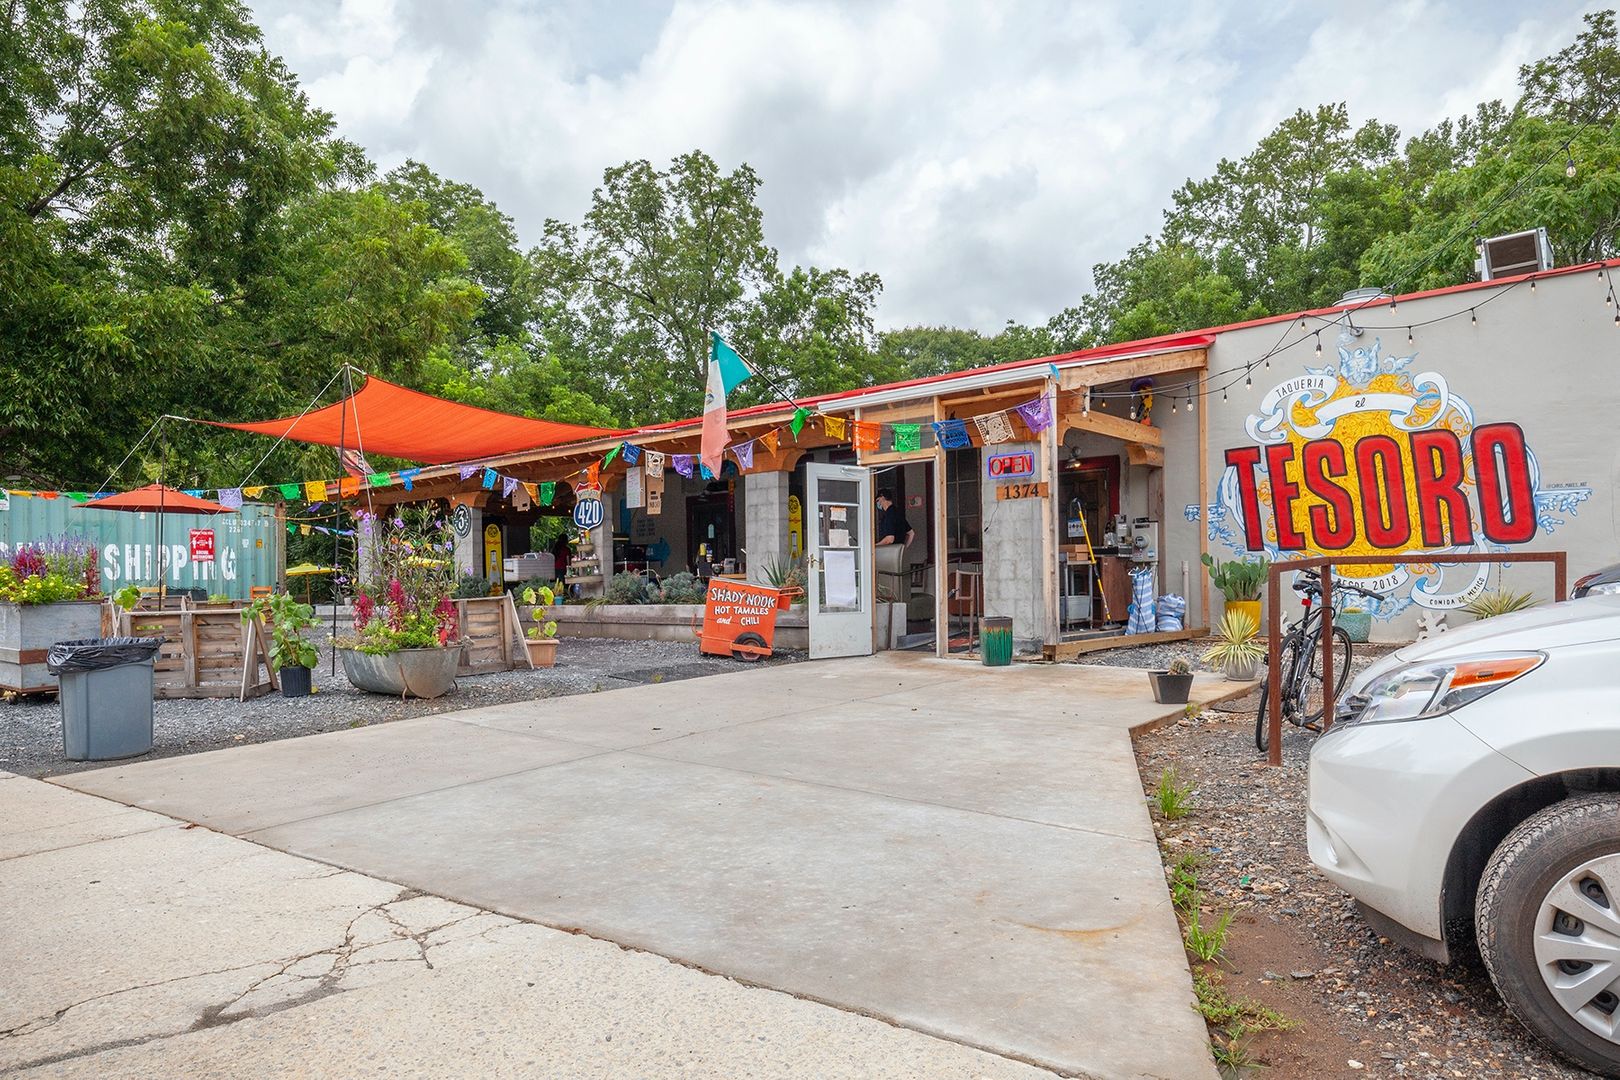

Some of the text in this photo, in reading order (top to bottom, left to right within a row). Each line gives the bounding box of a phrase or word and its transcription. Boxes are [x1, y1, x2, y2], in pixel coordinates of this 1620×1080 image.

[1275, 378, 1324, 398] TAQUERIA
[1354, 397, 1366, 408] el
[990, 454, 1032, 476] OPEN
[1004, 483, 1039, 499] 1374
[1225, 422, 1538, 552] TESORO
[458, 510, 465, 530] 3
[578, 501, 599, 524] 420
[103, 543, 237, 580] SHIPPING
[1372, 575, 1399, 591] 2018
[711, 588, 776, 608] SHADY NOOK
[714, 605, 769, 616] HOT TAMALES
[716, 616, 760, 626] and CHILI
